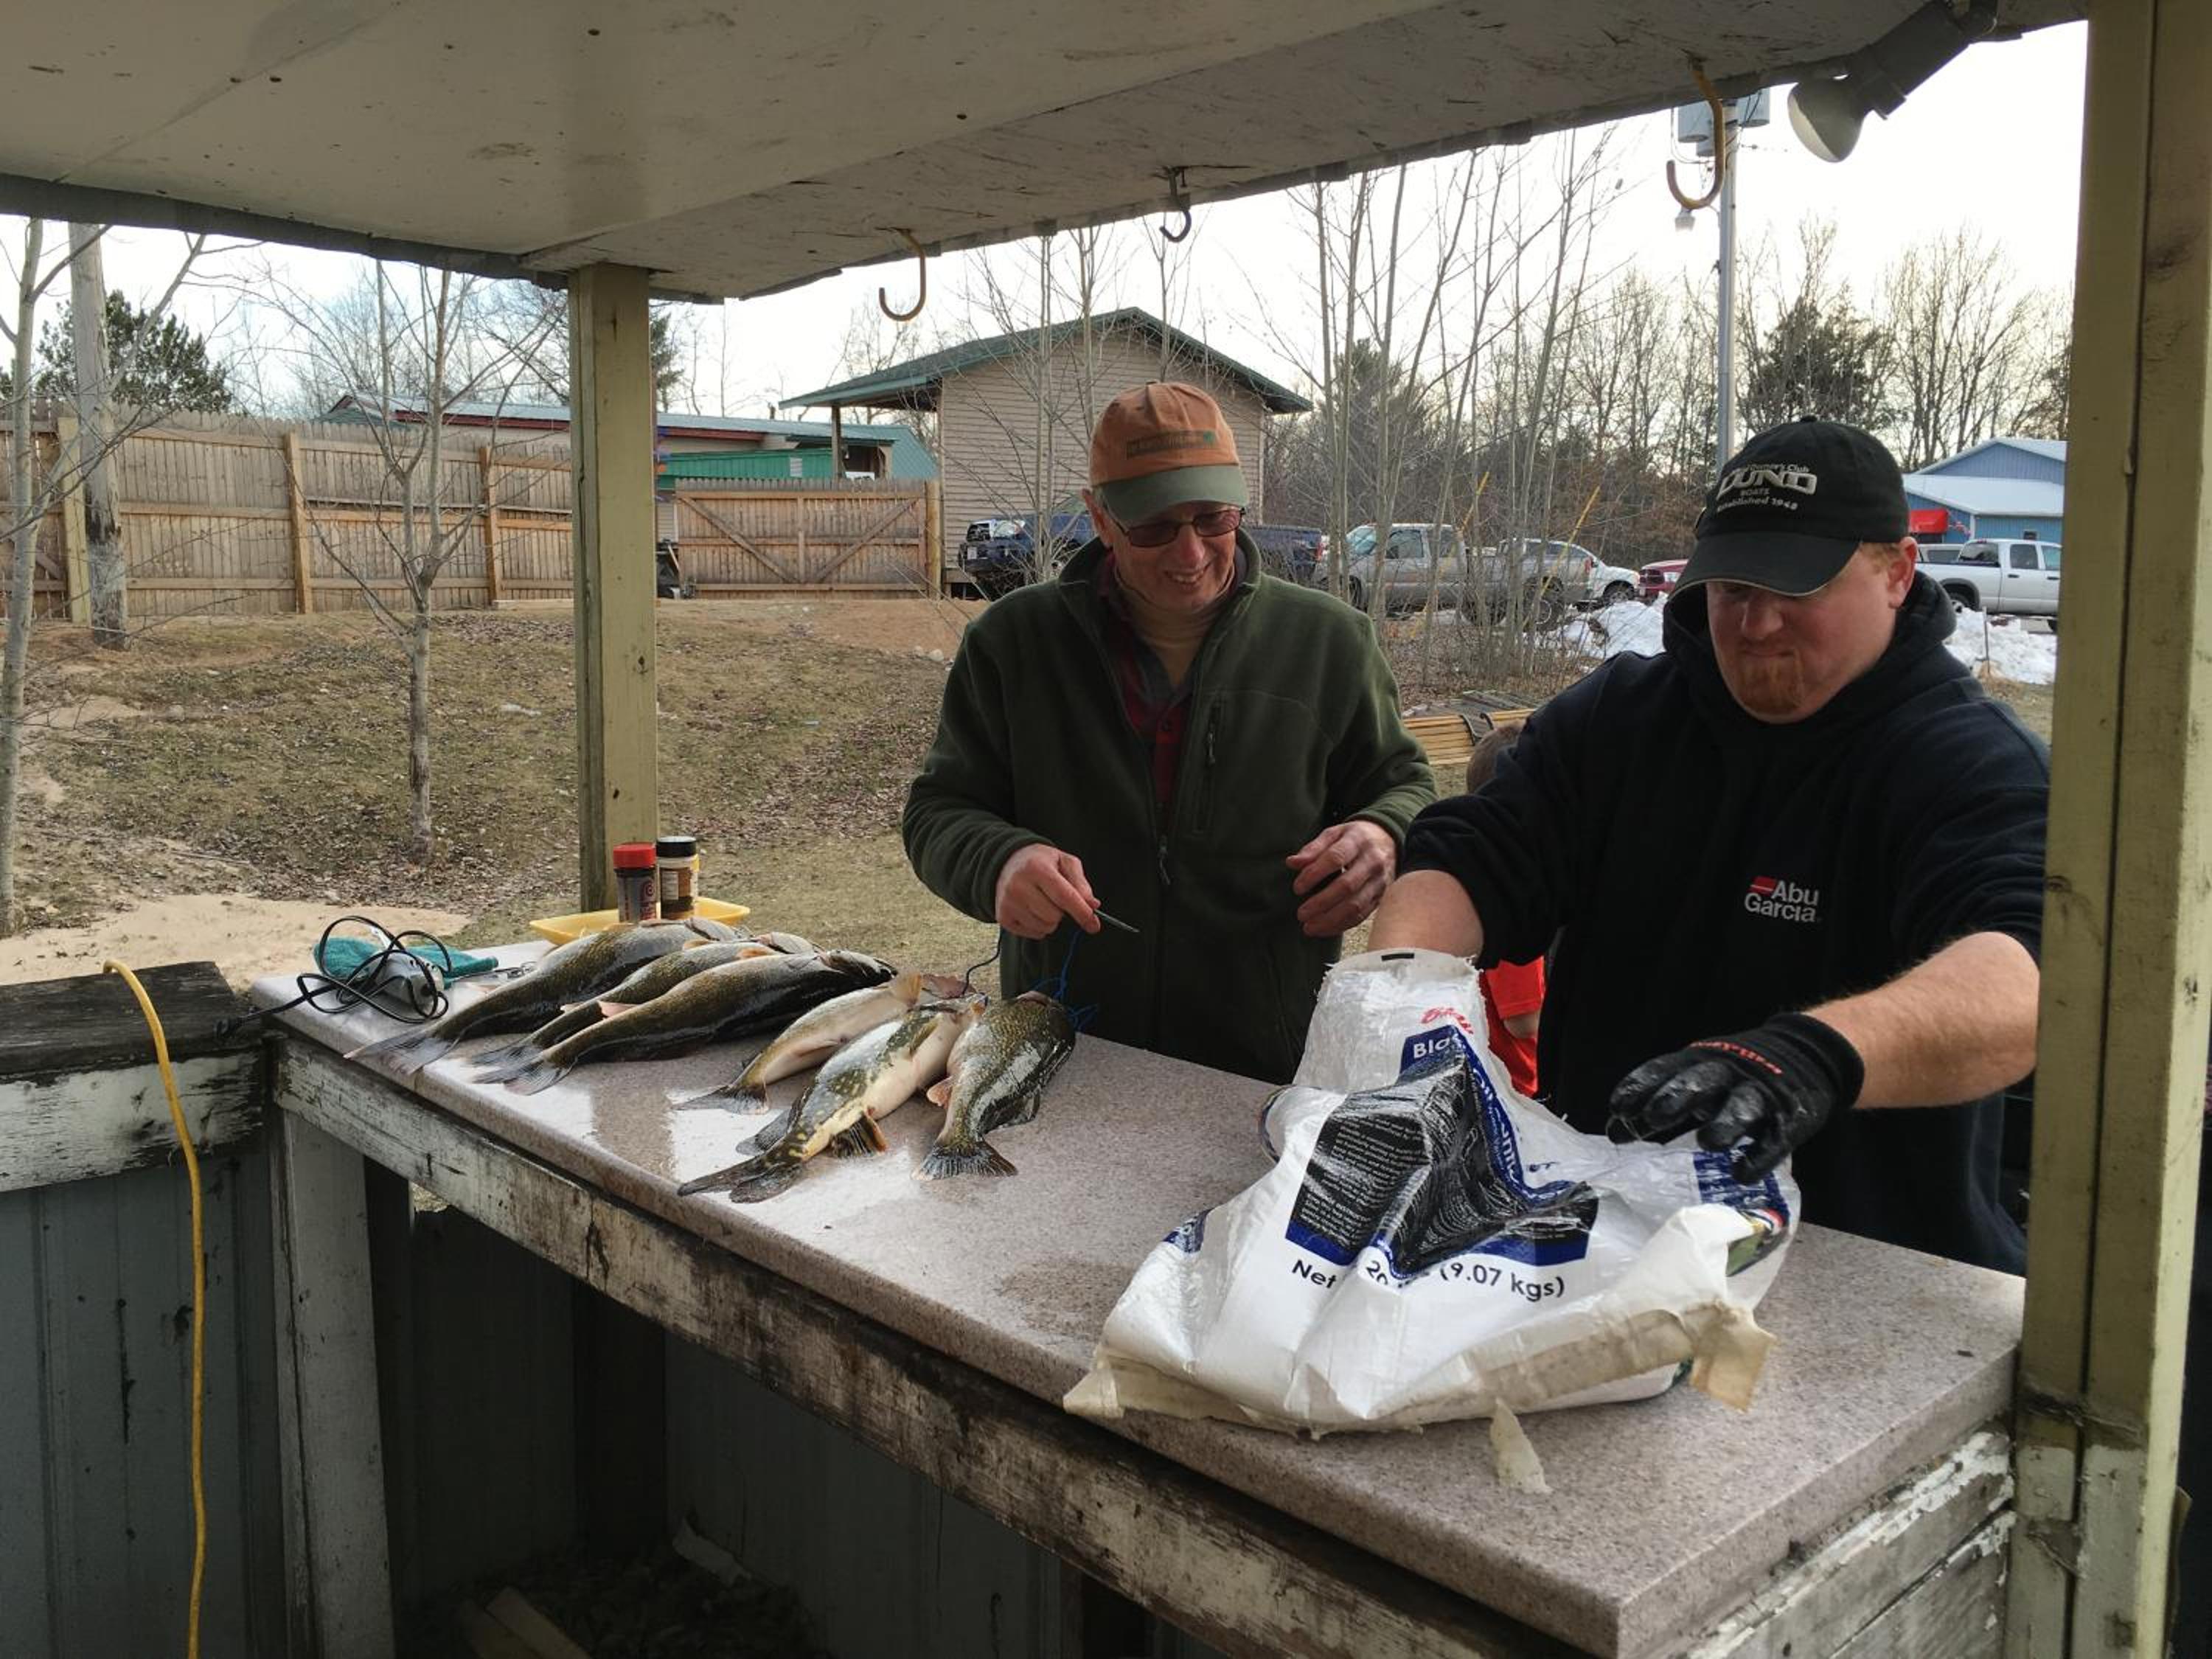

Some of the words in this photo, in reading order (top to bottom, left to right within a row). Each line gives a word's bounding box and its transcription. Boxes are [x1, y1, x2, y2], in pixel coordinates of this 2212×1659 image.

[1744, 892, 1816, 922] Garcia
[1771, 880, 1819, 906] Abu
[1292, 1259, 1337, 1289] Net
[1439, 1262, 1501, 1287] (9.07
[1511, 1272, 1565, 1302] kgs)
